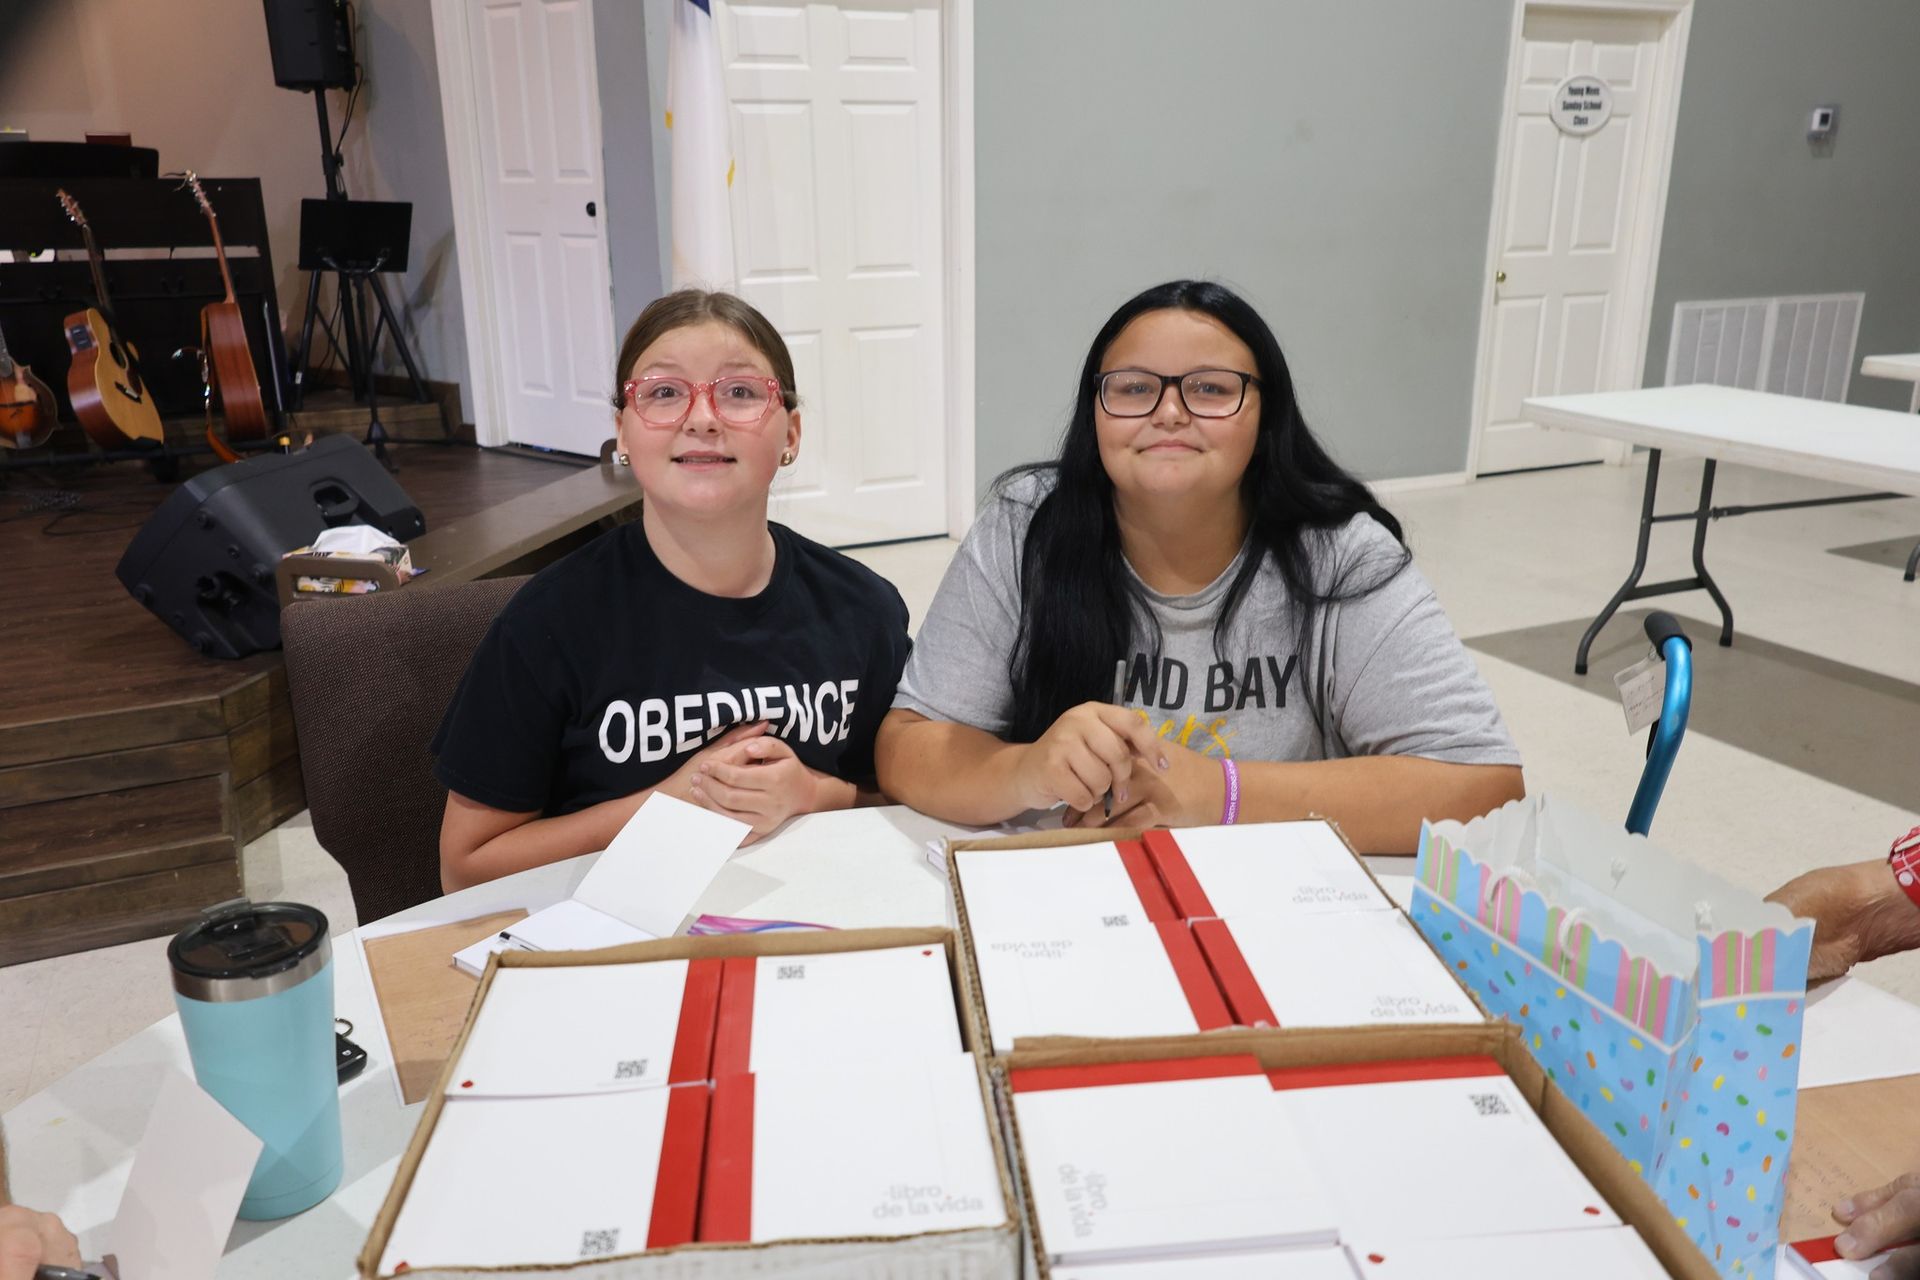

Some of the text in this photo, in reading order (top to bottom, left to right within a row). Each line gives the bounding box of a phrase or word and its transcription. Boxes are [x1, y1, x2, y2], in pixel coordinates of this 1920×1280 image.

[1568, 86, 1584, 97] Young
[1562, 100, 1602, 111] Sunday School
[1573, 115, 1588, 126] Class
[1204, 655, 1298, 713] BAY
[598, 679, 859, 764] OBEDIENCE
[1058, 1163, 1081, 1184] de
[889, 1184, 943, 1200] libro
[1063, 1186, 1085, 1202] la
[872, 1195, 984, 1219] de la vida
